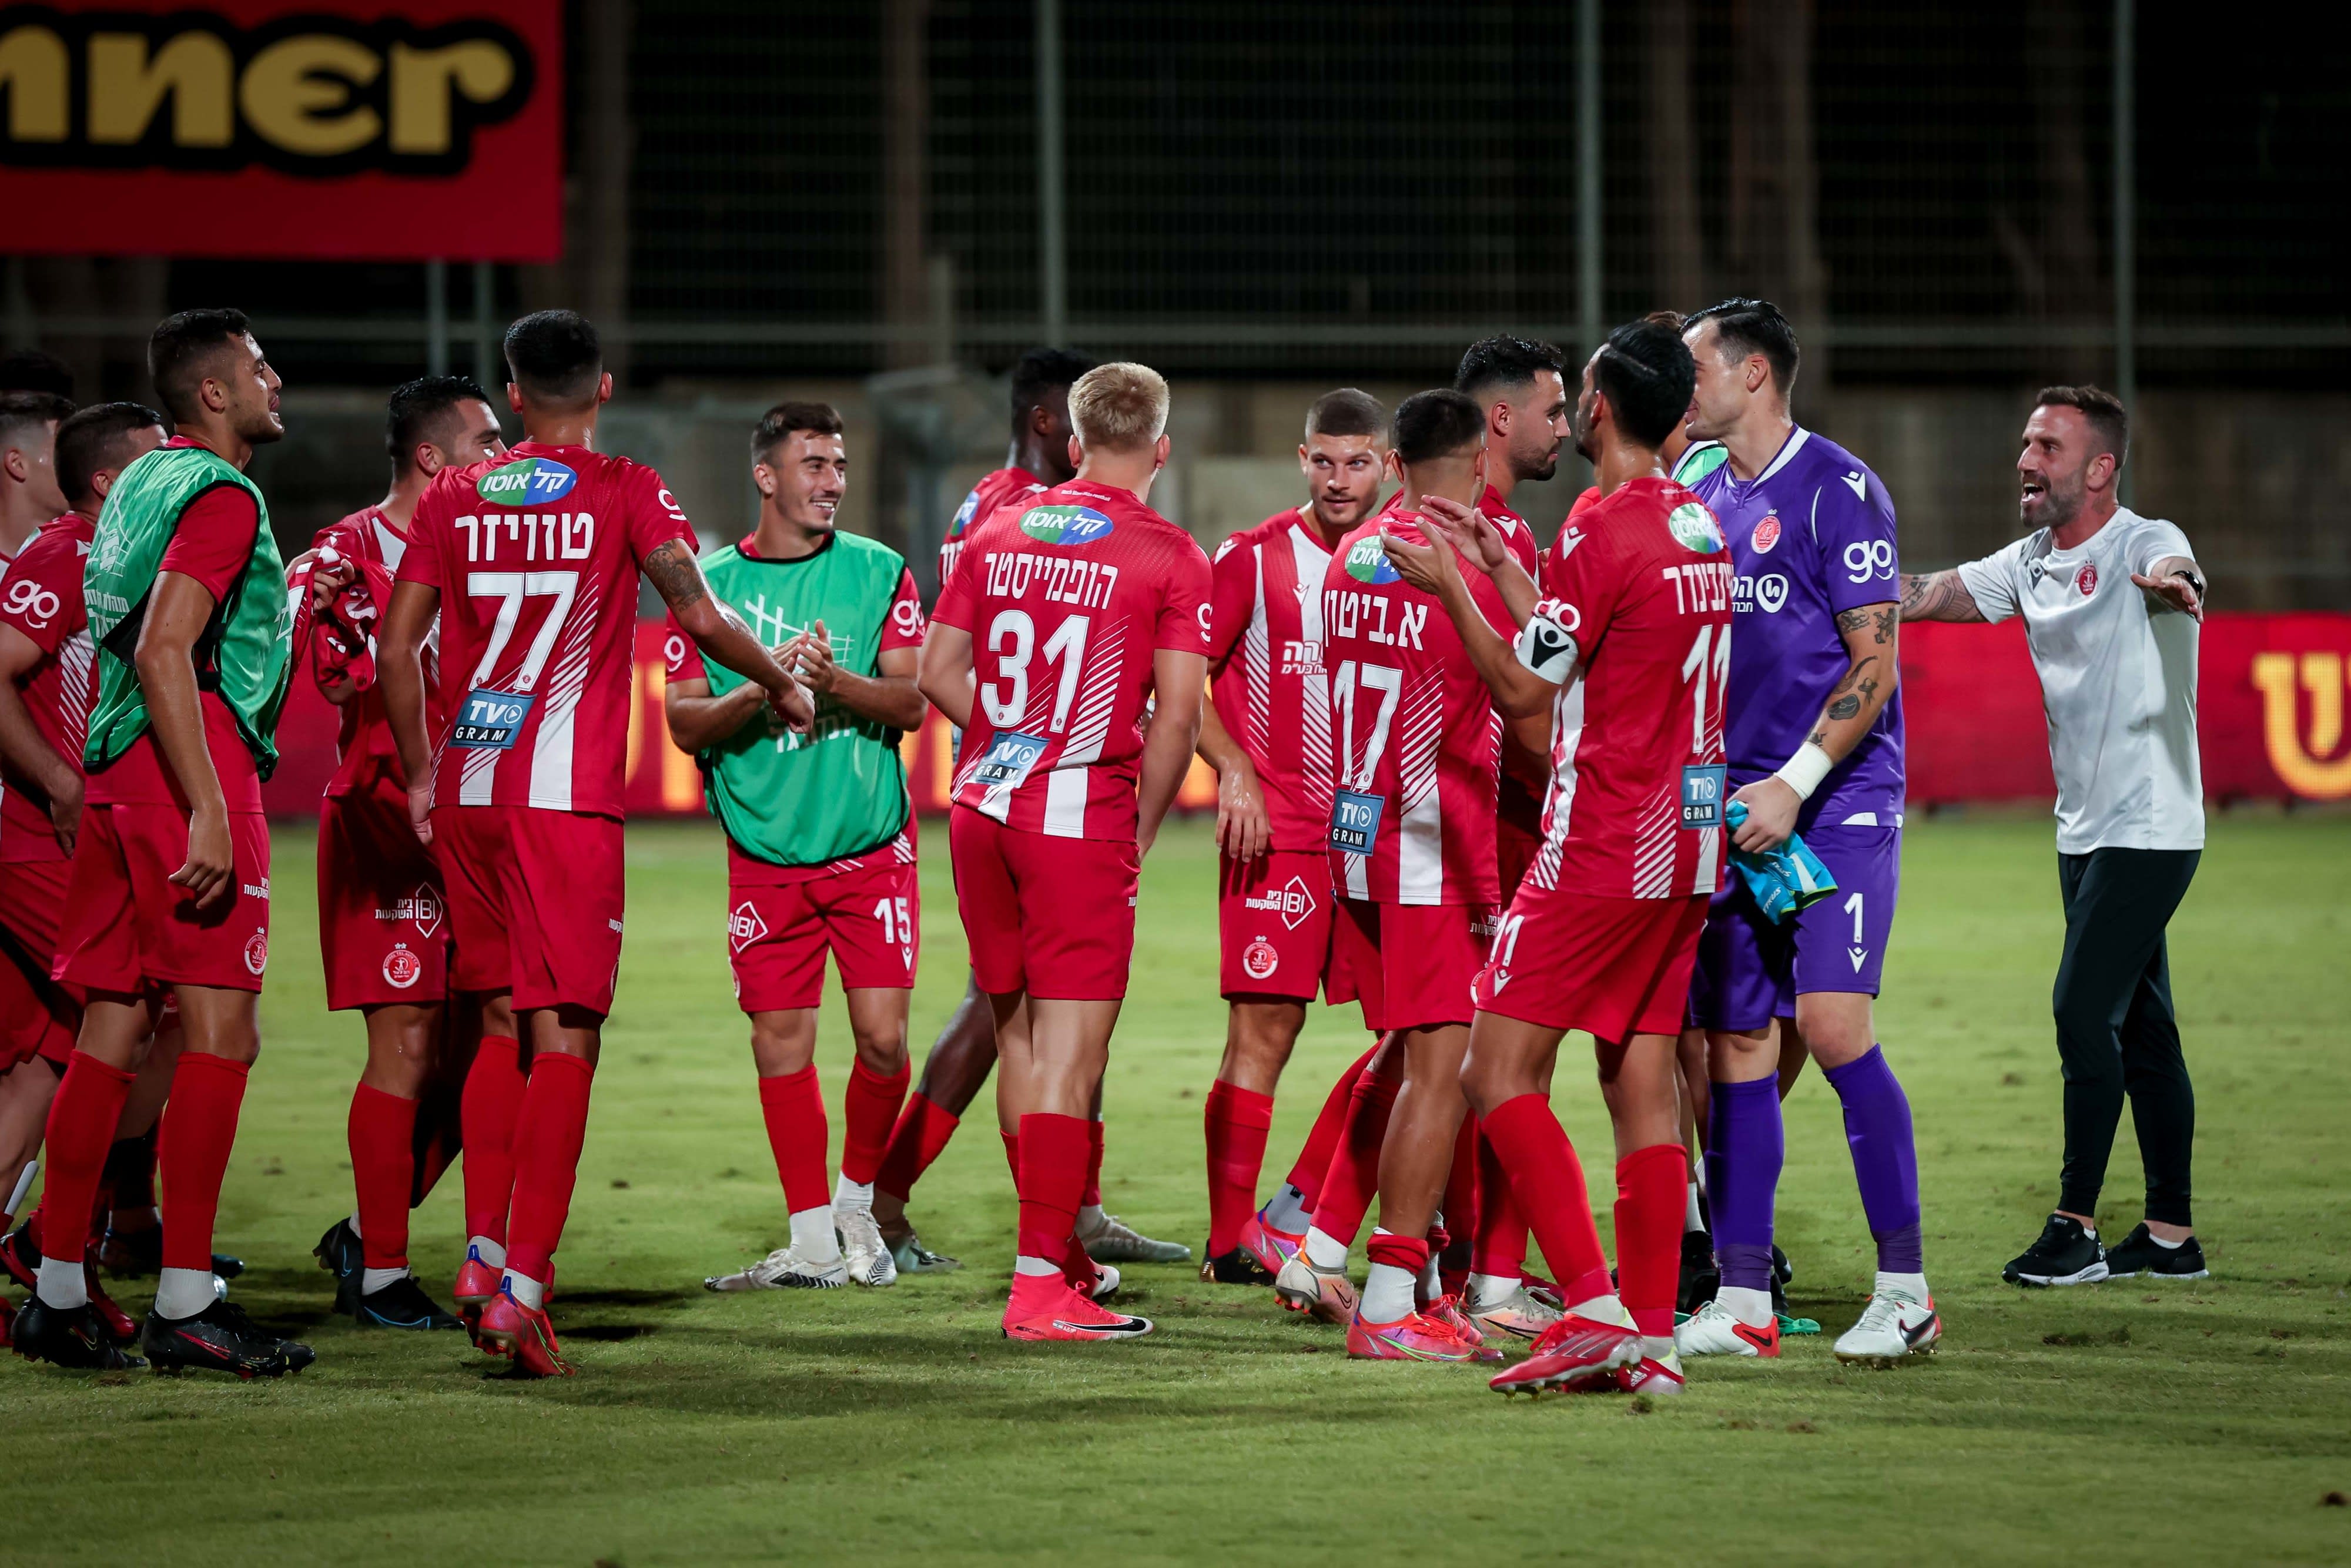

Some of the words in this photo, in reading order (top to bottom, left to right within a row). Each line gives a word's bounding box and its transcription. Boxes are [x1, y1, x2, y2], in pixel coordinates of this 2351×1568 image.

[483, 473, 531, 492] אוטו
[531, 468, 570, 493] קל
[1024, 511, 1072, 529] אוטו
[1071, 514, 1106, 535] קל
[1844, 540, 1892, 582] go
[984, 553, 1118, 609] הופמייסטר
[3, 580, 59, 618] go
[468, 571, 579, 691] 77
[981, 609, 1090, 732] 31
[1682, 624, 1732, 753] 11
[456, 726, 505, 742] GRAM
[1333, 660, 1403, 789] 17
[976, 765, 1017, 779] GRAM
[1684, 806, 1712, 820] GRAM
[1333, 828, 1364, 845] GRAM
[397, 899, 413, 909] בית
[1245, 898, 1281, 910] השקעות
[1267, 890, 1282, 900] בית
[1282, 892, 1305, 913] IBI
[375, 909, 413, 921] השקעות
[416, 899, 436, 920] IBI
[1844, 892, 1863, 943] 1
[732, 915, 756, 939] IBI
[873, 897, 911, 944] 15
[1489, 911, 1525, 967] 11
